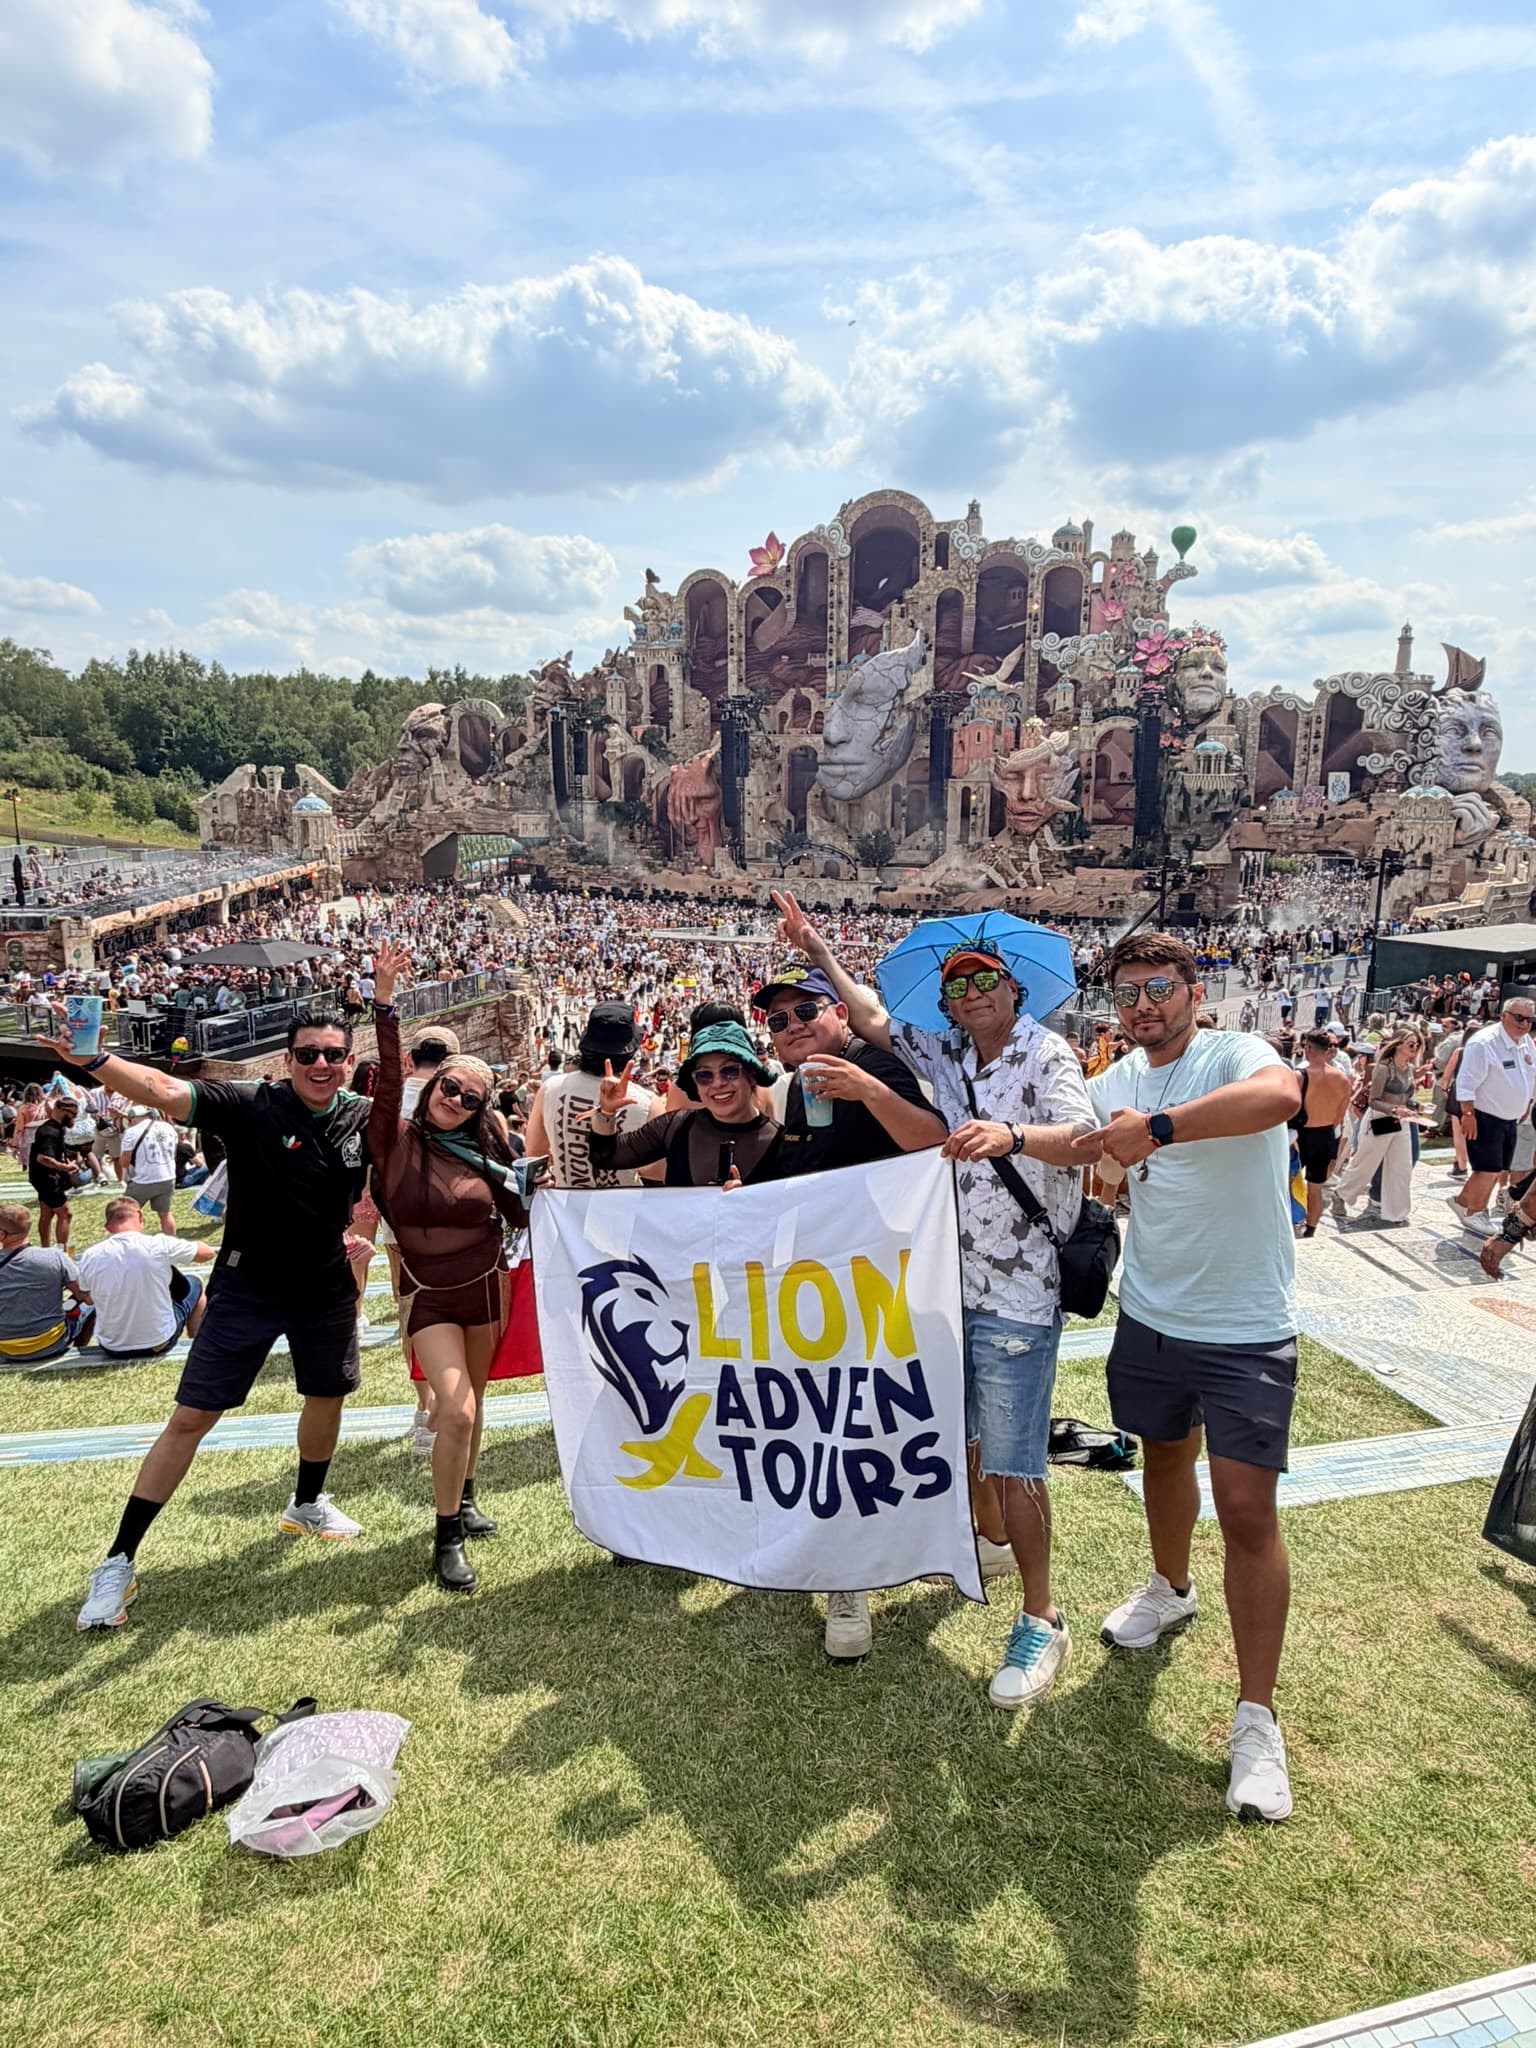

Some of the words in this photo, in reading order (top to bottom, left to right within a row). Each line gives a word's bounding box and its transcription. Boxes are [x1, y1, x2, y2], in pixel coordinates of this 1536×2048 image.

[692, 1249, 917, 1361] LION
[715, 1359, 935, 1439] ADVEN
[718, 1431, 952, 1521] TOURS
